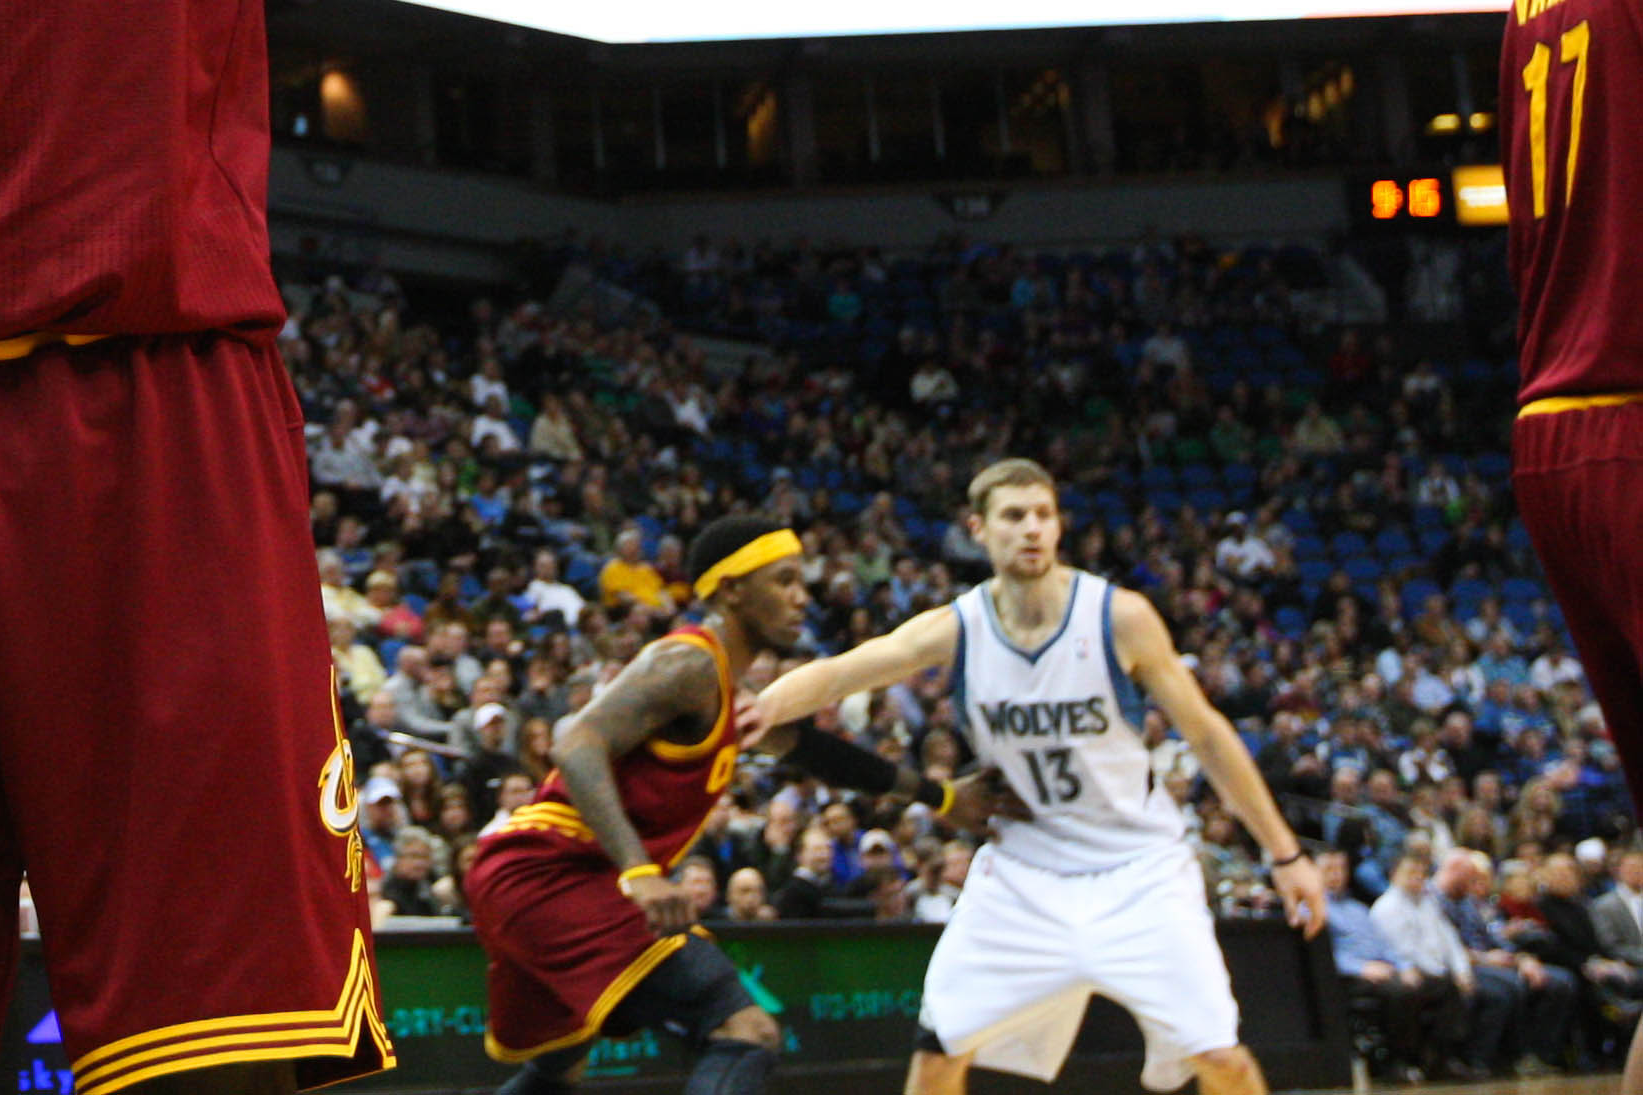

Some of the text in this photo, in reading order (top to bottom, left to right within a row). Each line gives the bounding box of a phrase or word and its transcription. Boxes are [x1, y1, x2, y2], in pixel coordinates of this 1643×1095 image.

[1522, 19, 1590, 219] 17
[979, 696, 1109, 736] WOLVES
[1021, 746, 1083, 805] 13
